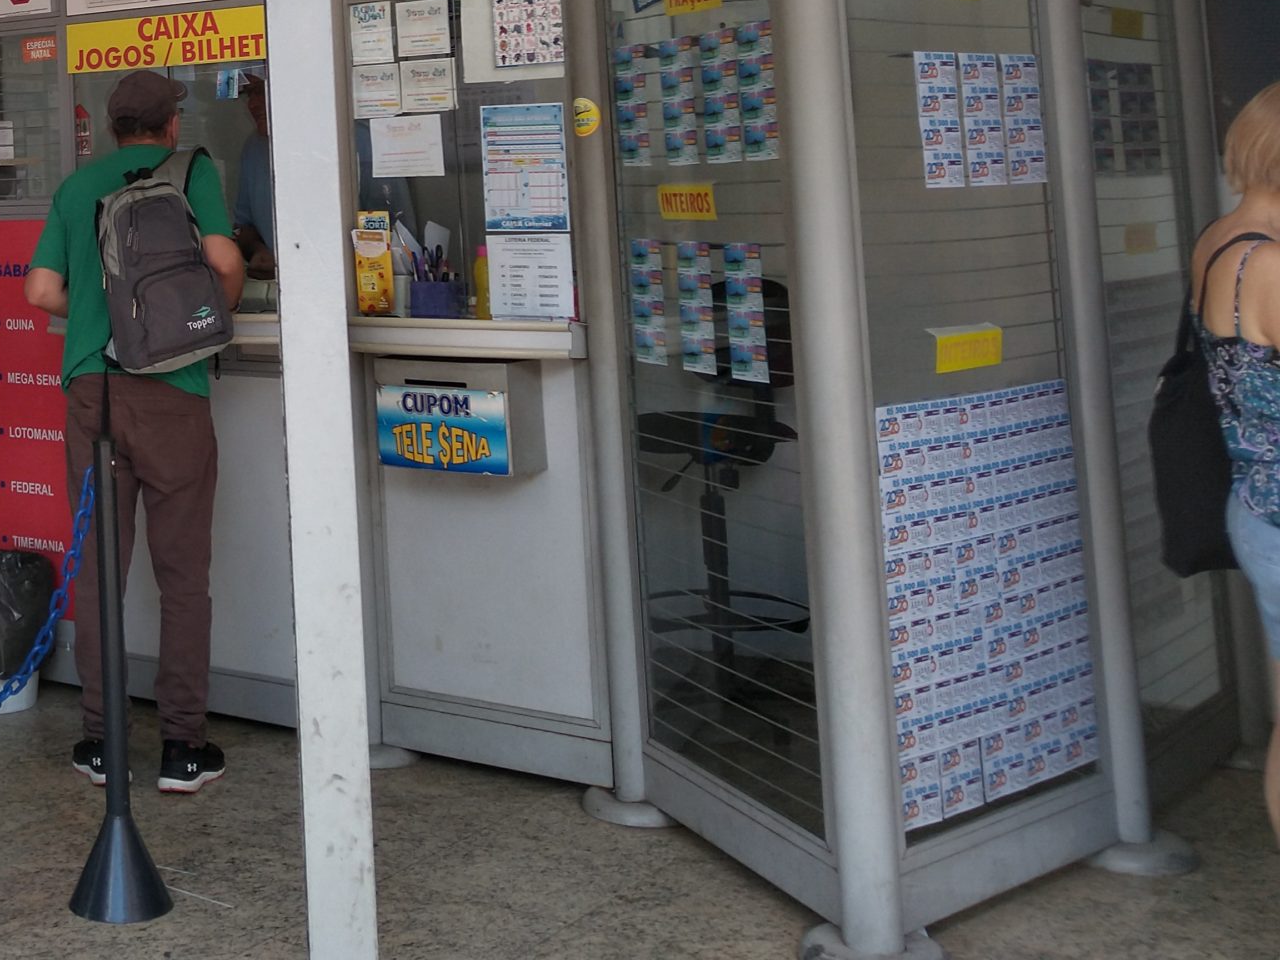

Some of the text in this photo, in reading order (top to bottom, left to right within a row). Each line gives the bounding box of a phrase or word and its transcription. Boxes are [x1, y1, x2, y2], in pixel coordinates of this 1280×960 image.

[137, 11, 220, 42] CAIXA
[27, 40, 56, 49] ESPECIAL
[74, 44, 155, 71] JOGOS
[181, 33, 264, 62] BILHET
[31, 50, 51, 59] NATAL
[661, 192, 711, 213] INTEIROS
[6, 319, 34, 331] QUINA
[187, 316, 215, 331] Topper
[8, 373, 62, 386] MEGA SENA
[402, 392, 470, 417] CUPOM
[9, 427, 64, 441] LOTOMANIA
[392, 422, 434, 464] TELE
[11, 481, 54, 496] FEDERAL
[12, 535, 64, 553] TIMEMANIA
